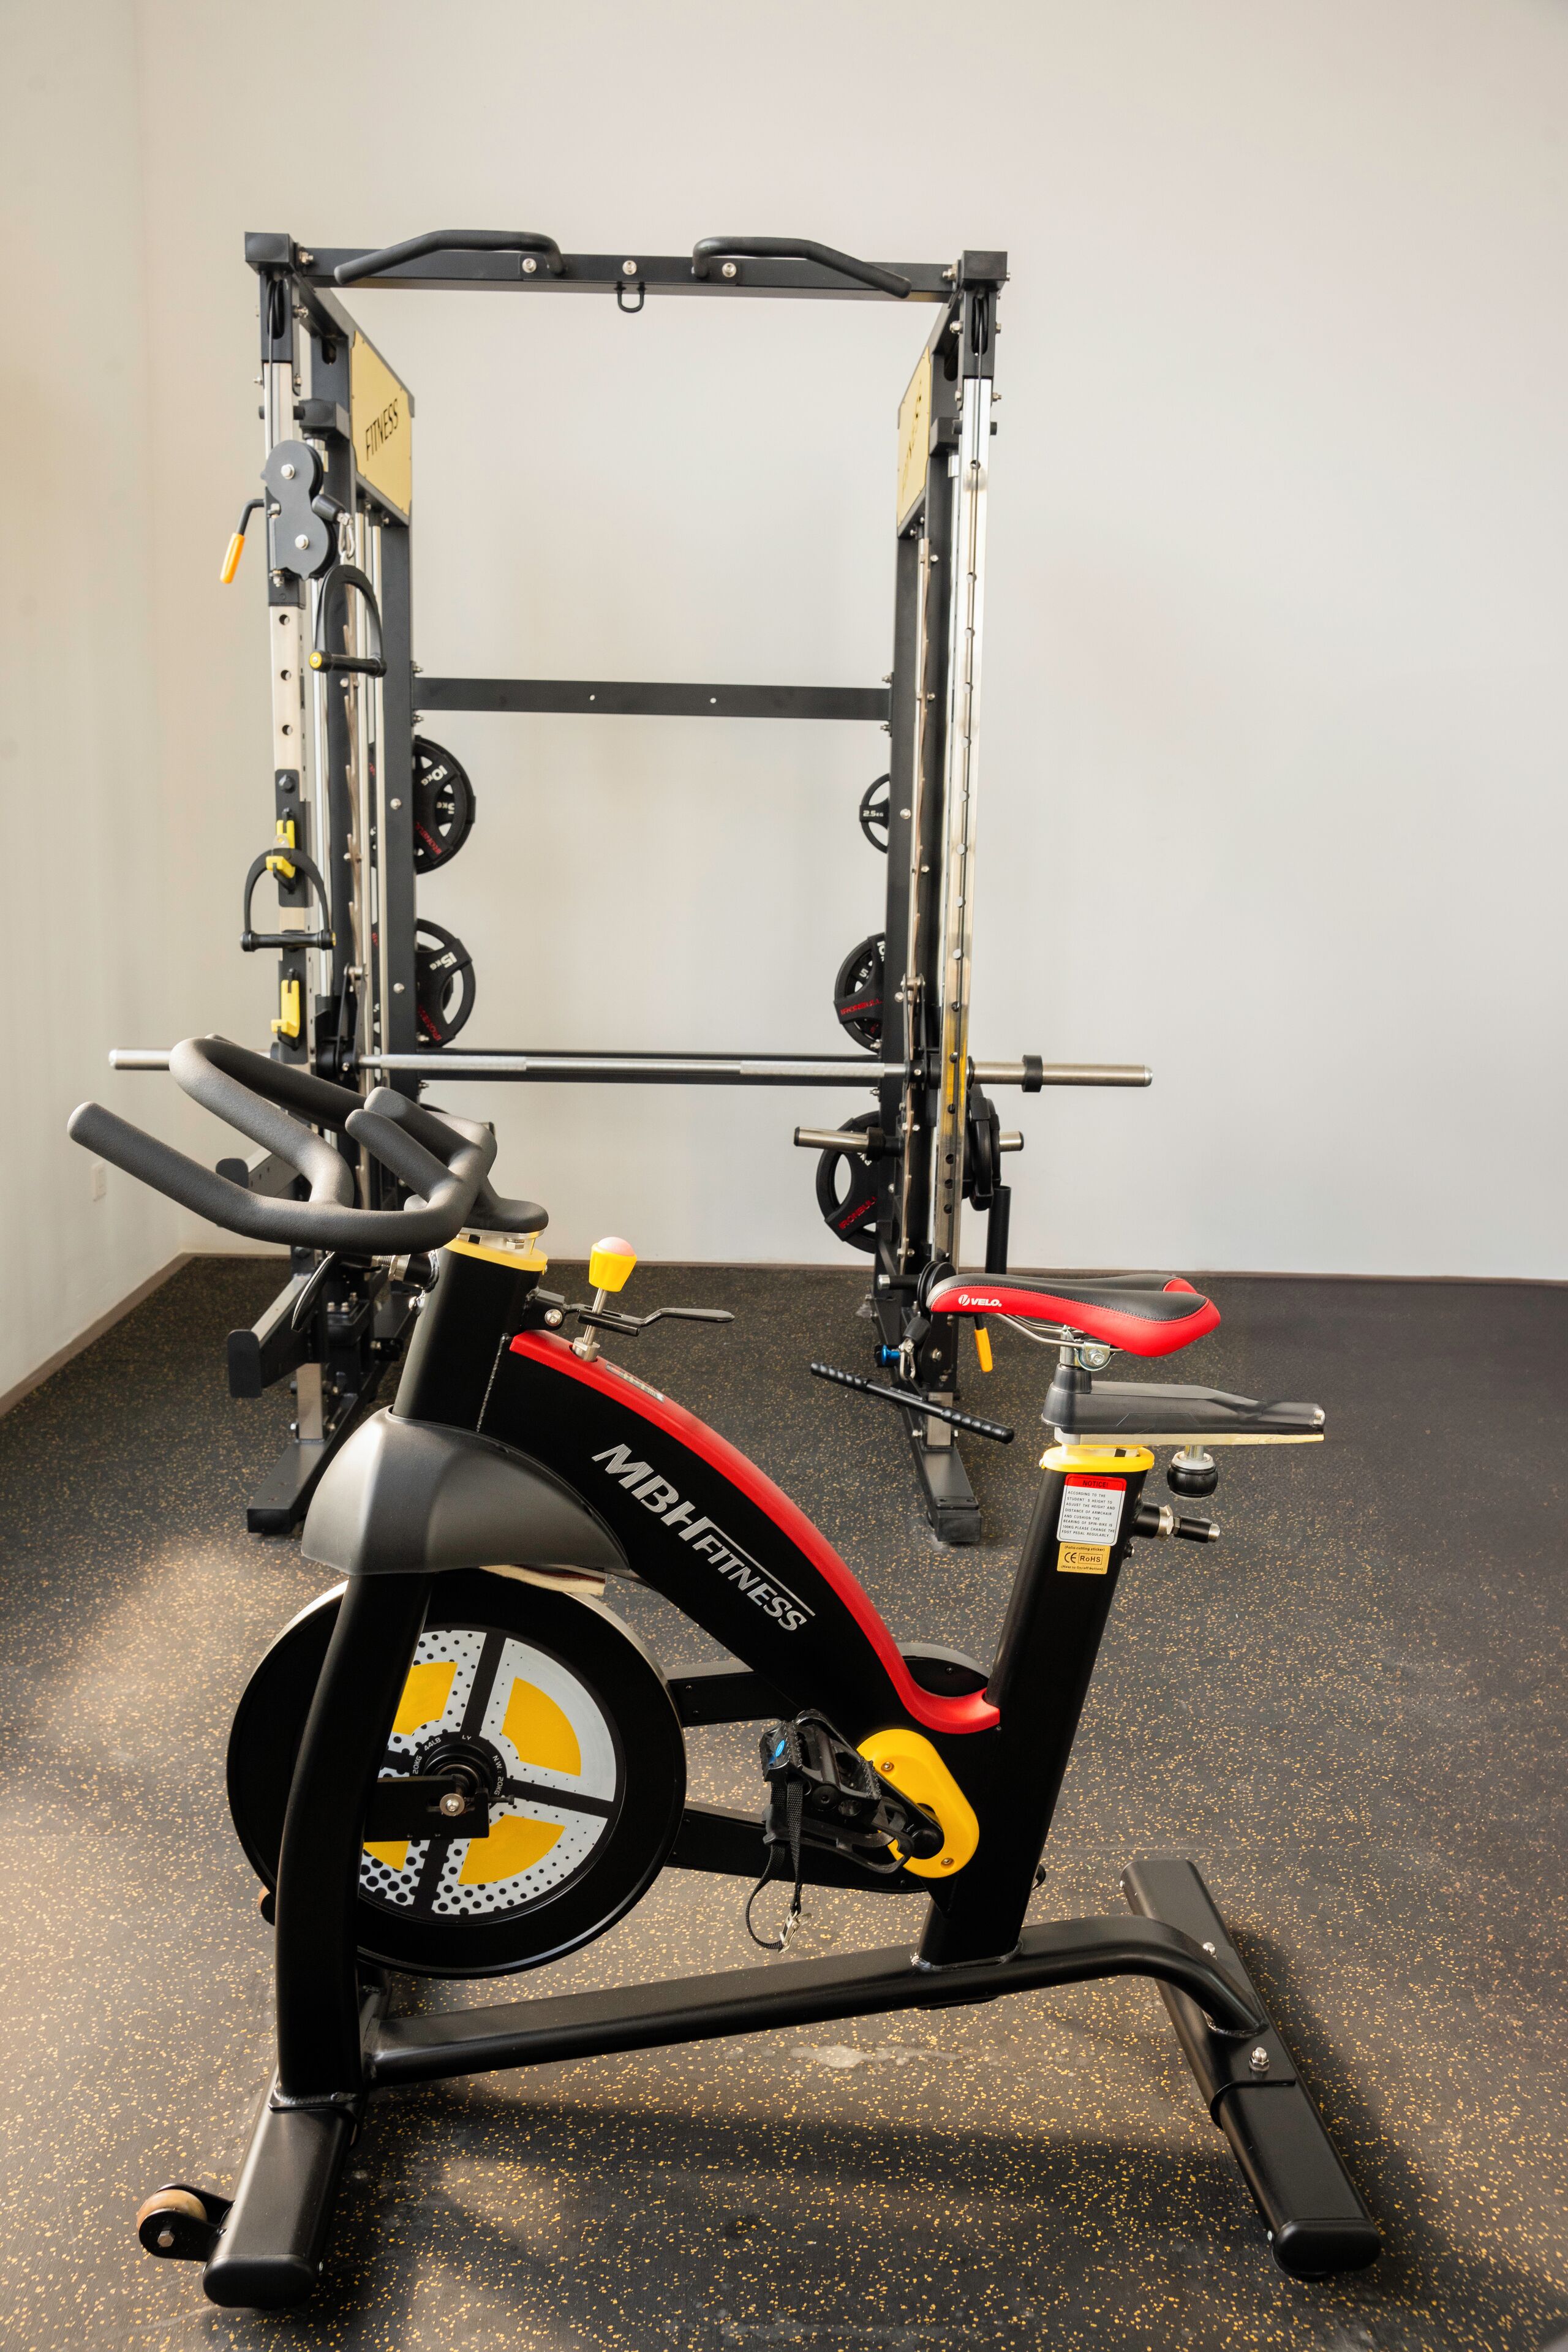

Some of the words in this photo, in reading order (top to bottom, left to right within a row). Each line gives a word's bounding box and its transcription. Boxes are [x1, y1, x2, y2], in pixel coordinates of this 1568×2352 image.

[366, 398, 398, 461] FITNESS
[421, 764, 448, 786] 10KG
[415, 821, 442, 856] IRONBUL
[429, 951, 458, 971] 15KG
[592, 1444, 710, 1542] MBH
[1065, 1552, 1077, 1563] CE
[692, 1534, 807, 1630] FITNESS
[412, 1755, 423, 1774] 20KG
[424, 1737, 442, 1751] 44LB
[494, 1776, 504, 1796] 20KG
